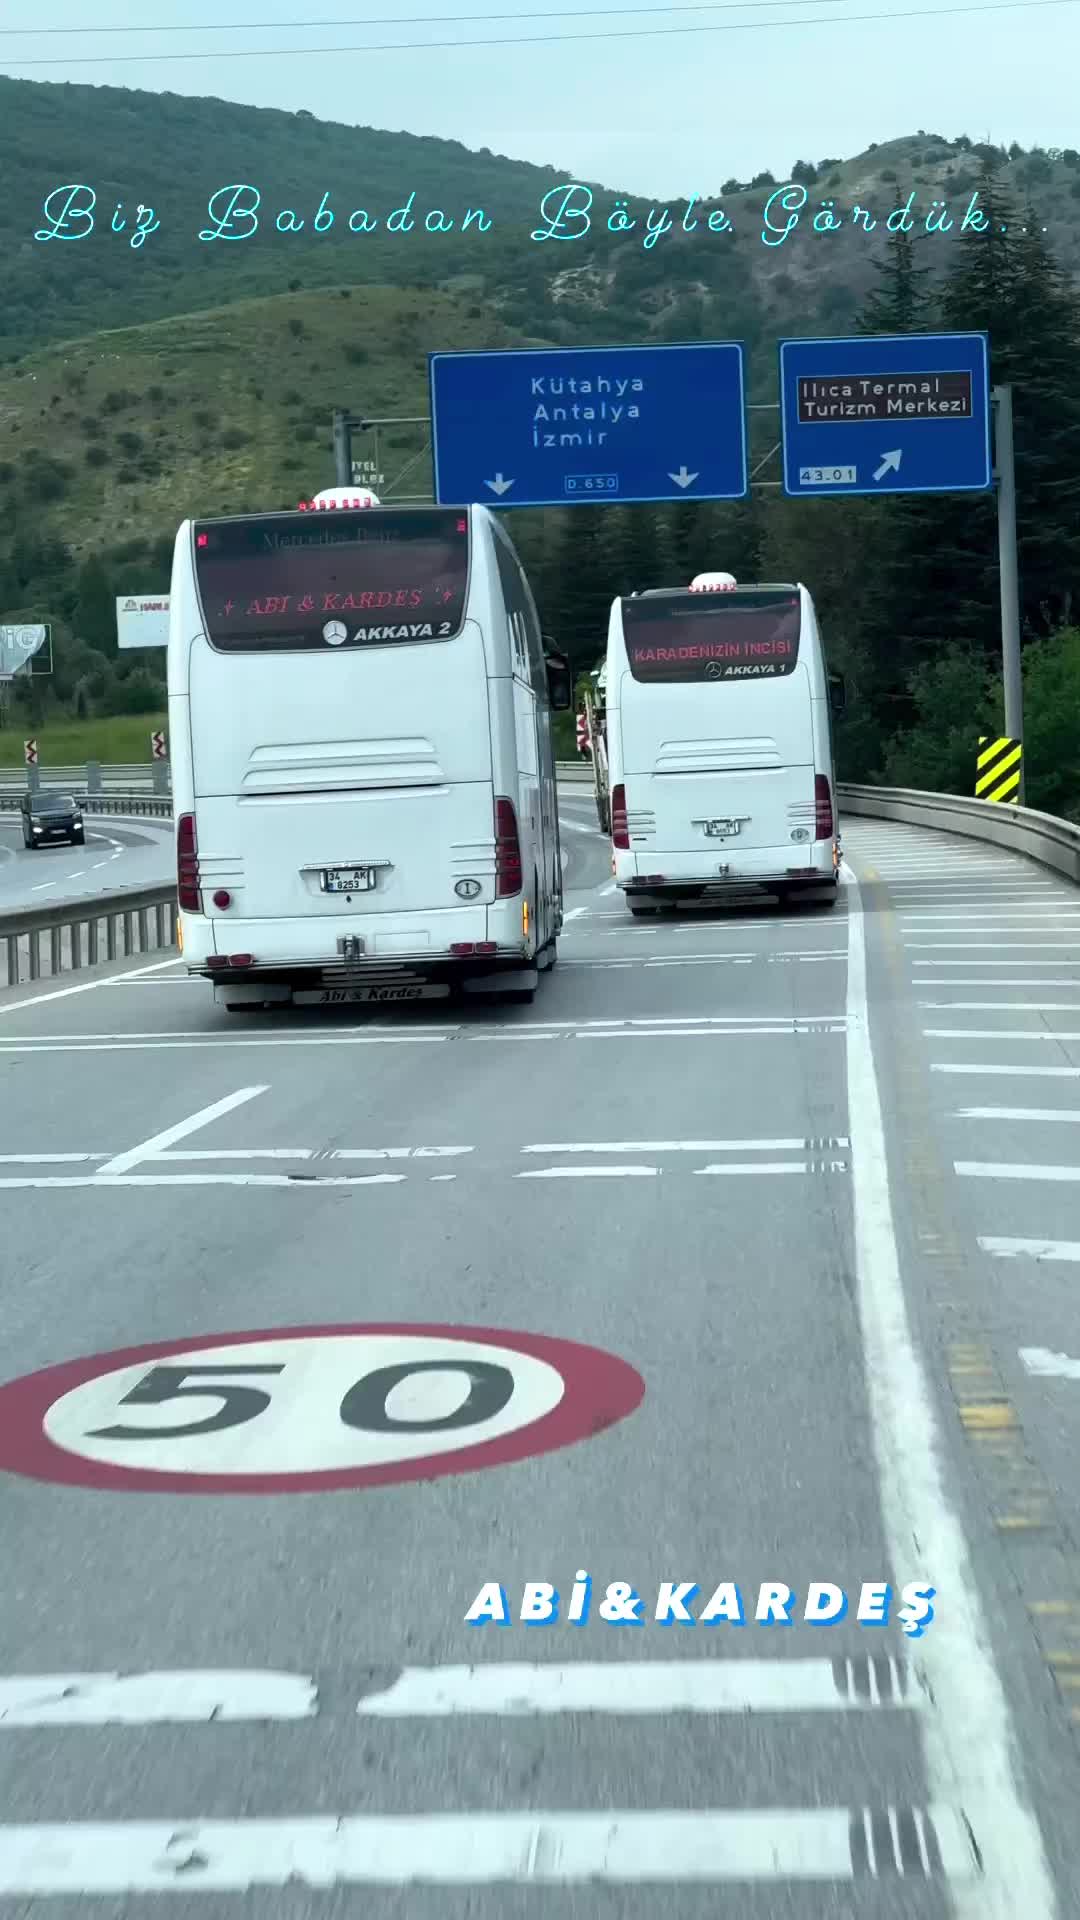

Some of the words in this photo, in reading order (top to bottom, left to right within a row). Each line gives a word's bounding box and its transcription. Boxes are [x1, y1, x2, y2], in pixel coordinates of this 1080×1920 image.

[531, 376, 644, 396] Kütahya
[859, 378, 940, 396] Termal
[533, 402, 641, 423] Antalya
[804, 401, 877, 417] Turizm
[886, 397, 967, 414] Merkezi
[533, 426, 608, 448] İzmir
[353, 623, 433, 642] AKKAYA
[438, 621, 451, 635] 2
[724, 664, 776, 676] AKKAYA
[779, 664, 786, 673] 1
[328, 872, 340, 881] 34
[353, 871, 367, 880] AK
[337, 881, 360, 889] 8253
[83, 1359, 516, 1441] 50
